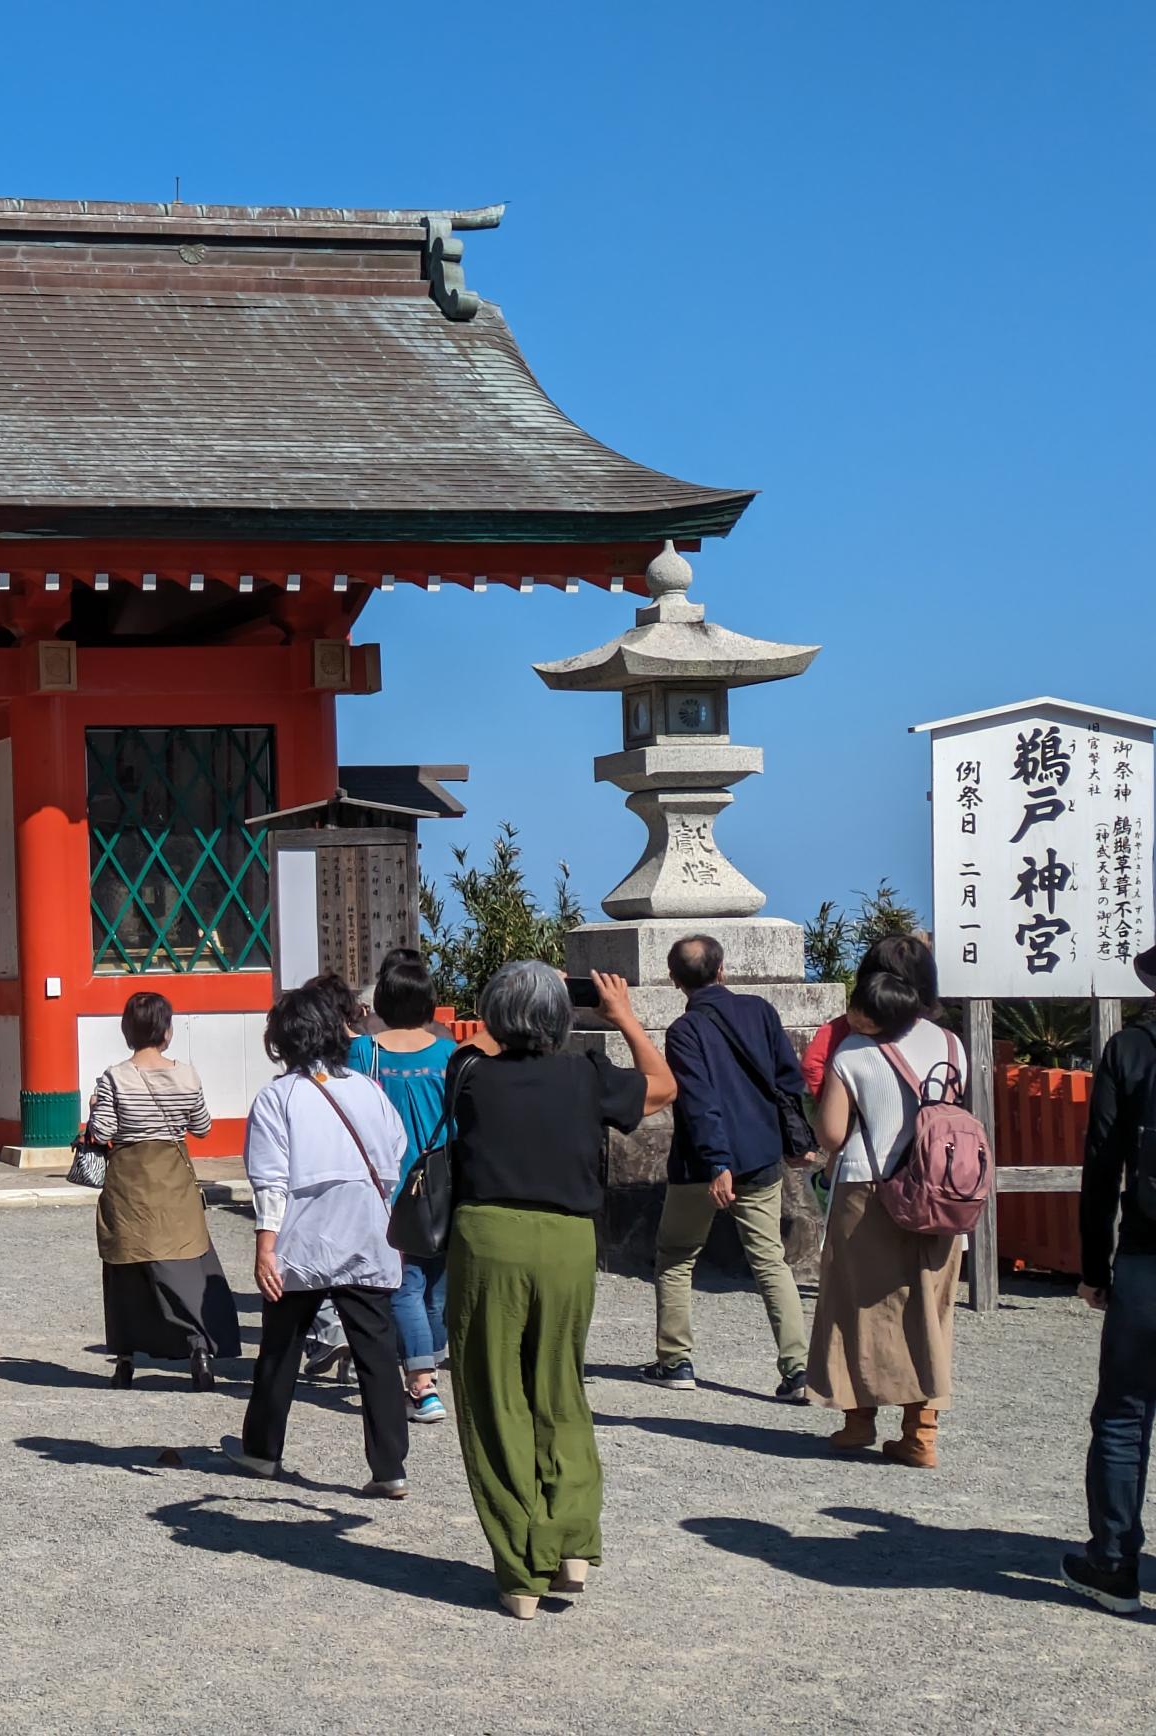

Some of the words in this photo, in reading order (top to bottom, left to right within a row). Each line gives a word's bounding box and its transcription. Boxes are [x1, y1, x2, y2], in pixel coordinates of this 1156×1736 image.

[956, 760, 983, 835] 例祭日
[1009, 725, 1071, 975] 鵜戸神宮
[959, 862, 981, 964] 二月一日
